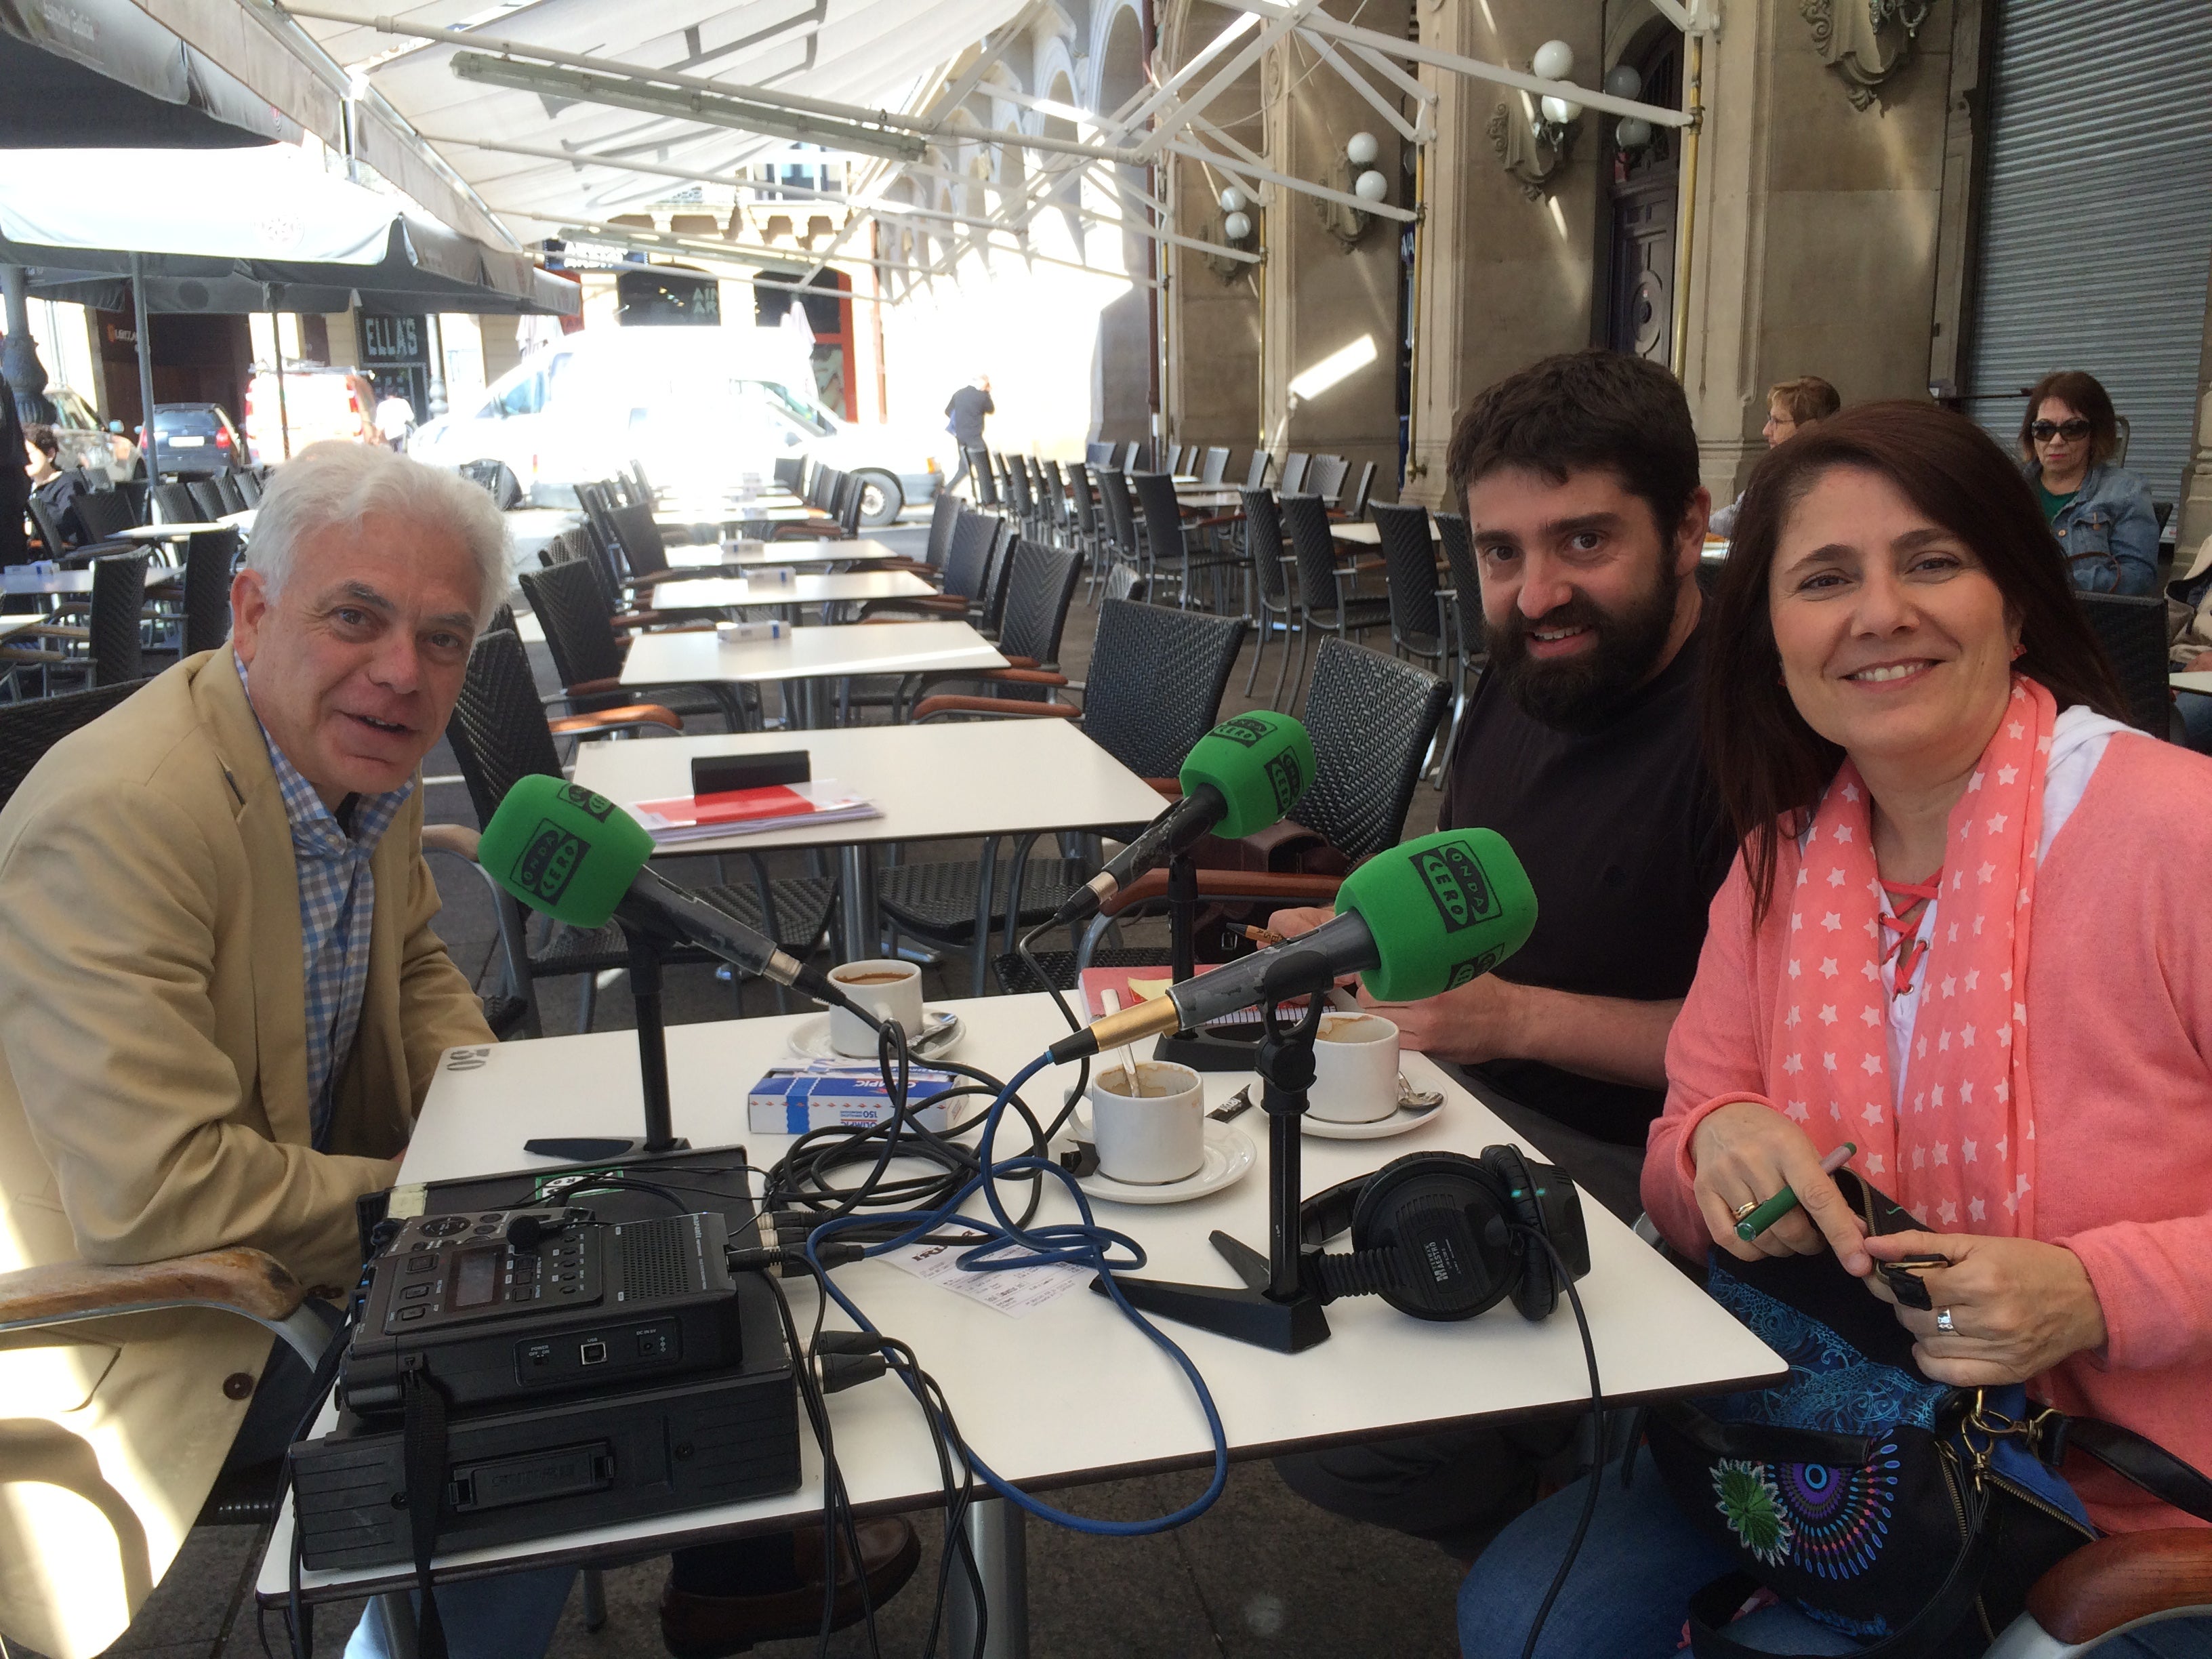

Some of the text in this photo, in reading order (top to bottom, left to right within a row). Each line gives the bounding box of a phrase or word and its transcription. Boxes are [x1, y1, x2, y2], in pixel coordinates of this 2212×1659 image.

[1218, 726, 1253, 739] CERO
[1275, 767, 1288, 805] CERO
[523, 835, 558, 884] ONDA
[541, 844, 575, 891] CERO
[1450, 851, 1484, 908] ONDA
[1429, 861, 1465, 916] CERO
[1429, 1242, 1449, 1282] MAESTRO
